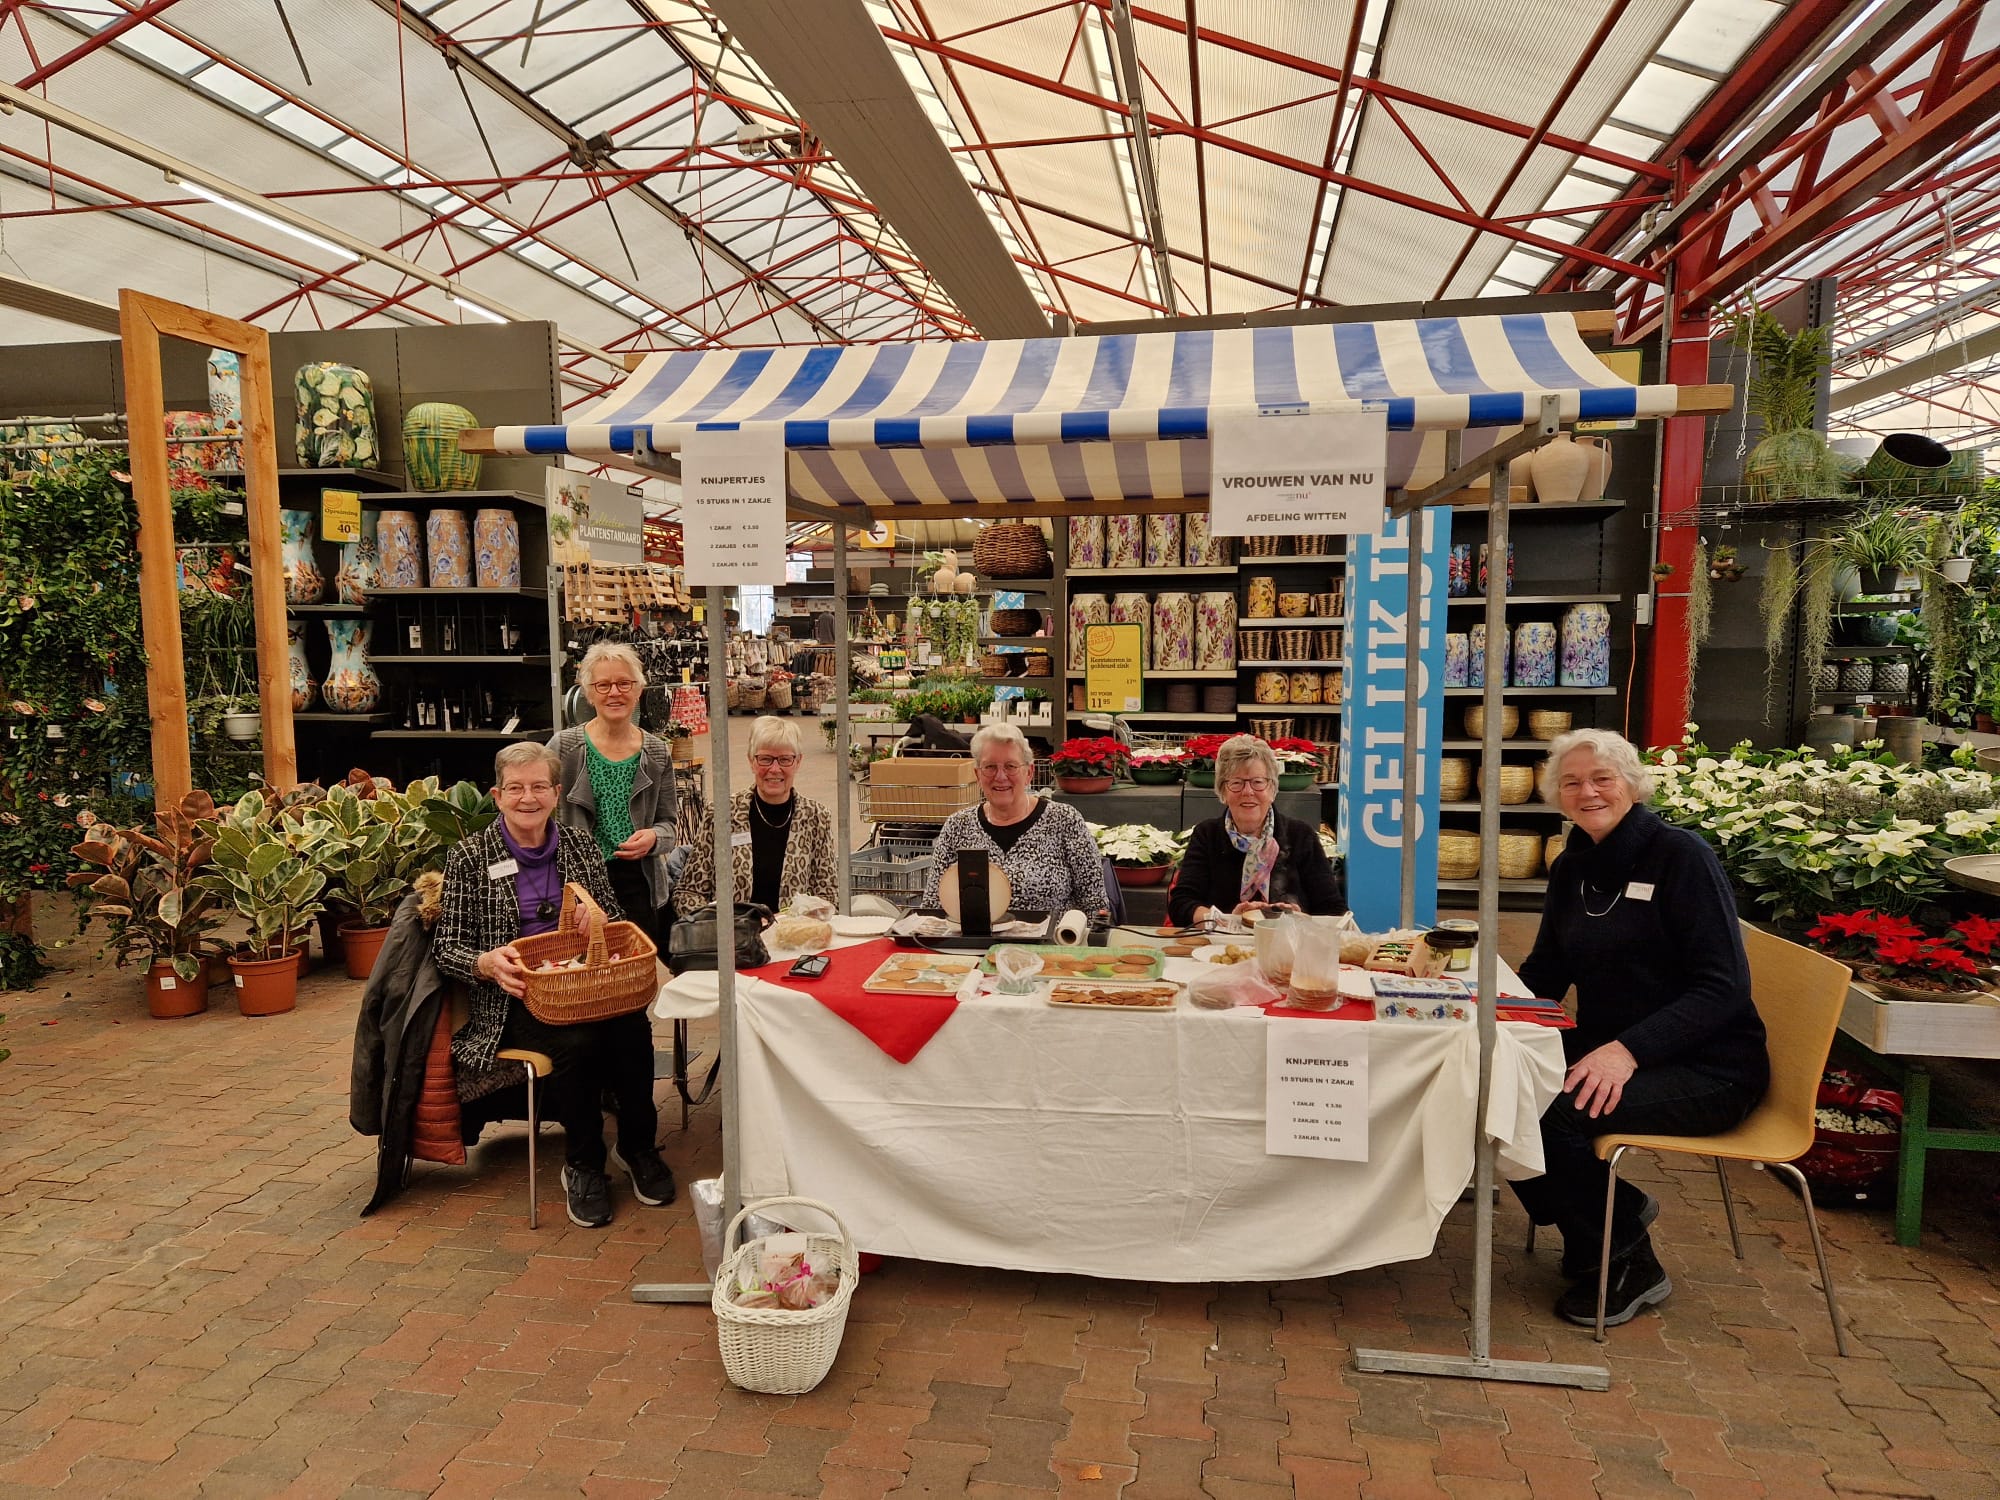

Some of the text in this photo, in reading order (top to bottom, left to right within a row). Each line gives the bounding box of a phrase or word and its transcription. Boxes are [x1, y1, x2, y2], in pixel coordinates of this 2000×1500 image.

[701, 476, 766, 485] KNIJPERTJES
[1222, 473, 1374, 488] VROUWEN VAN NU
[1246, 512, 1347, 522] AFDELING WITTEN
[580, 525, 640, 544] PLANTENSTANDAARD
[1286, 1058, 1349, 1067] KNIJPERTJES
